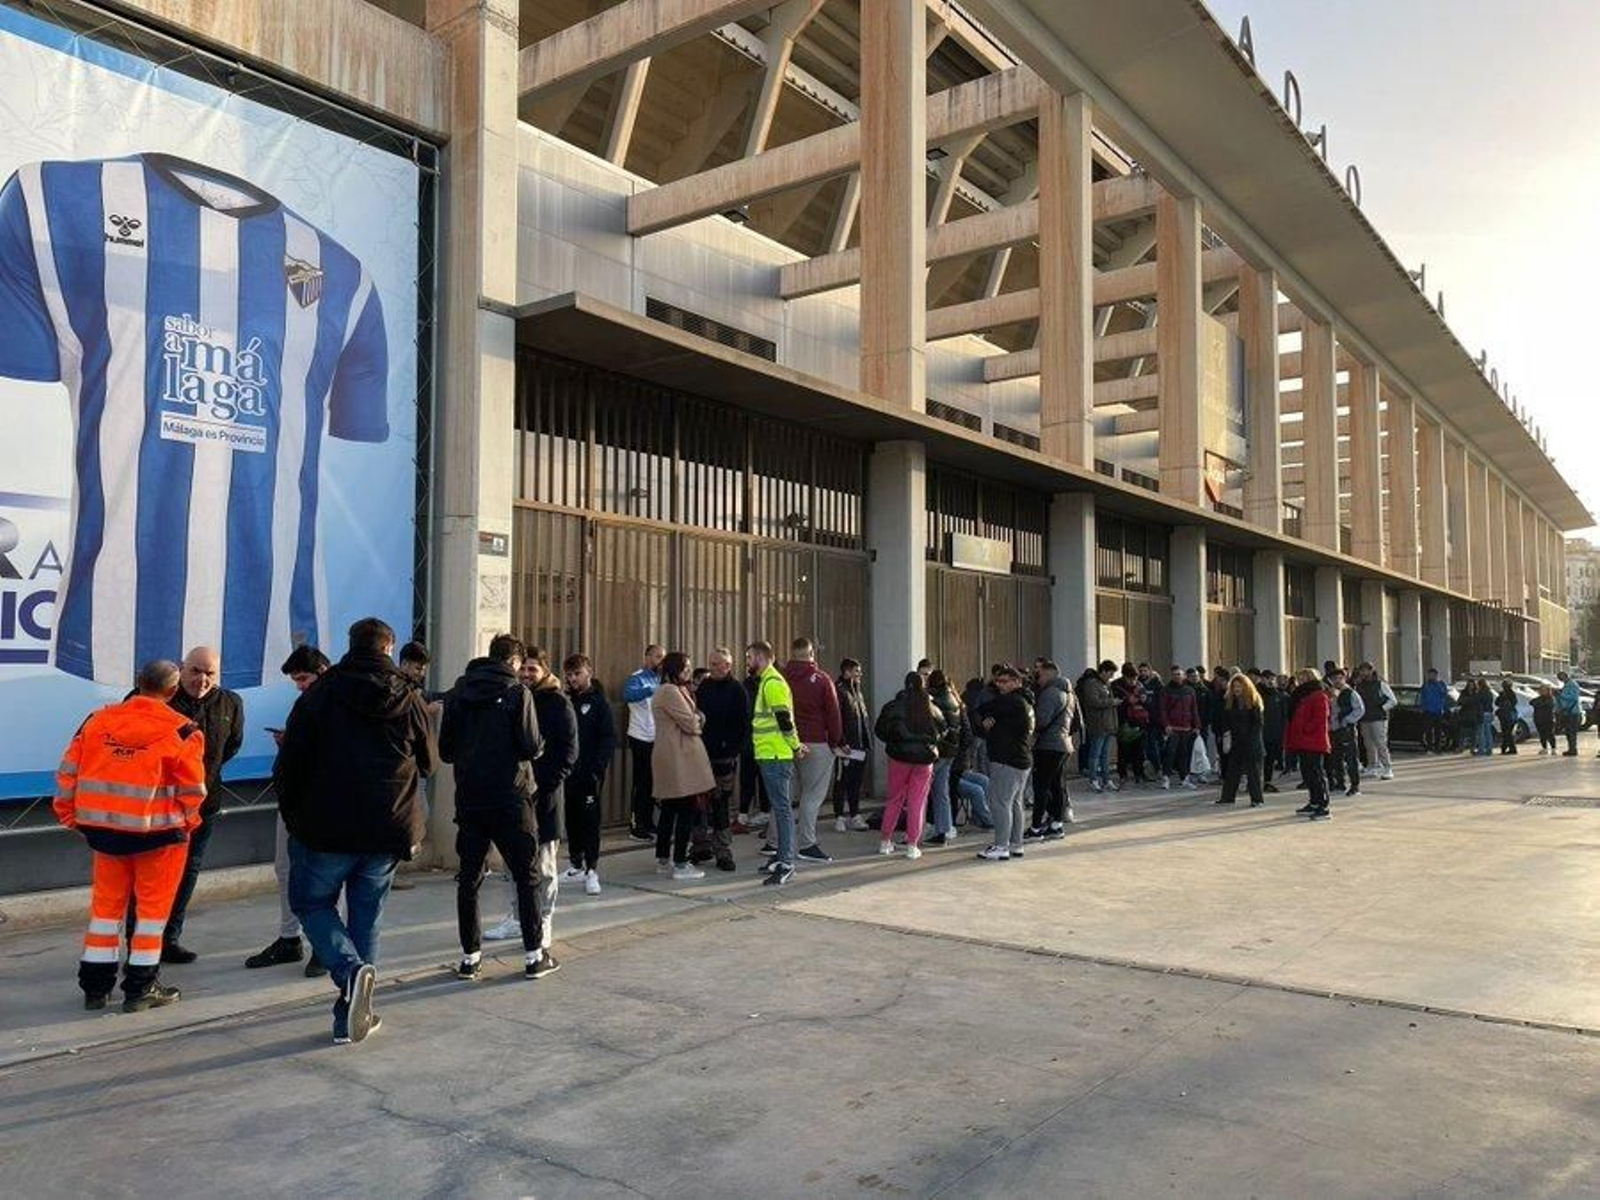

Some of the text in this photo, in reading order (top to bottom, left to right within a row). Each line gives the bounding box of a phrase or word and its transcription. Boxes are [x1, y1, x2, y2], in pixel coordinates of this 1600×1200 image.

[164, 314, 216, 339] sabor
[163, 353, 266, 421] laga
[162, 420, 264, 446] Málaga es Provincia
